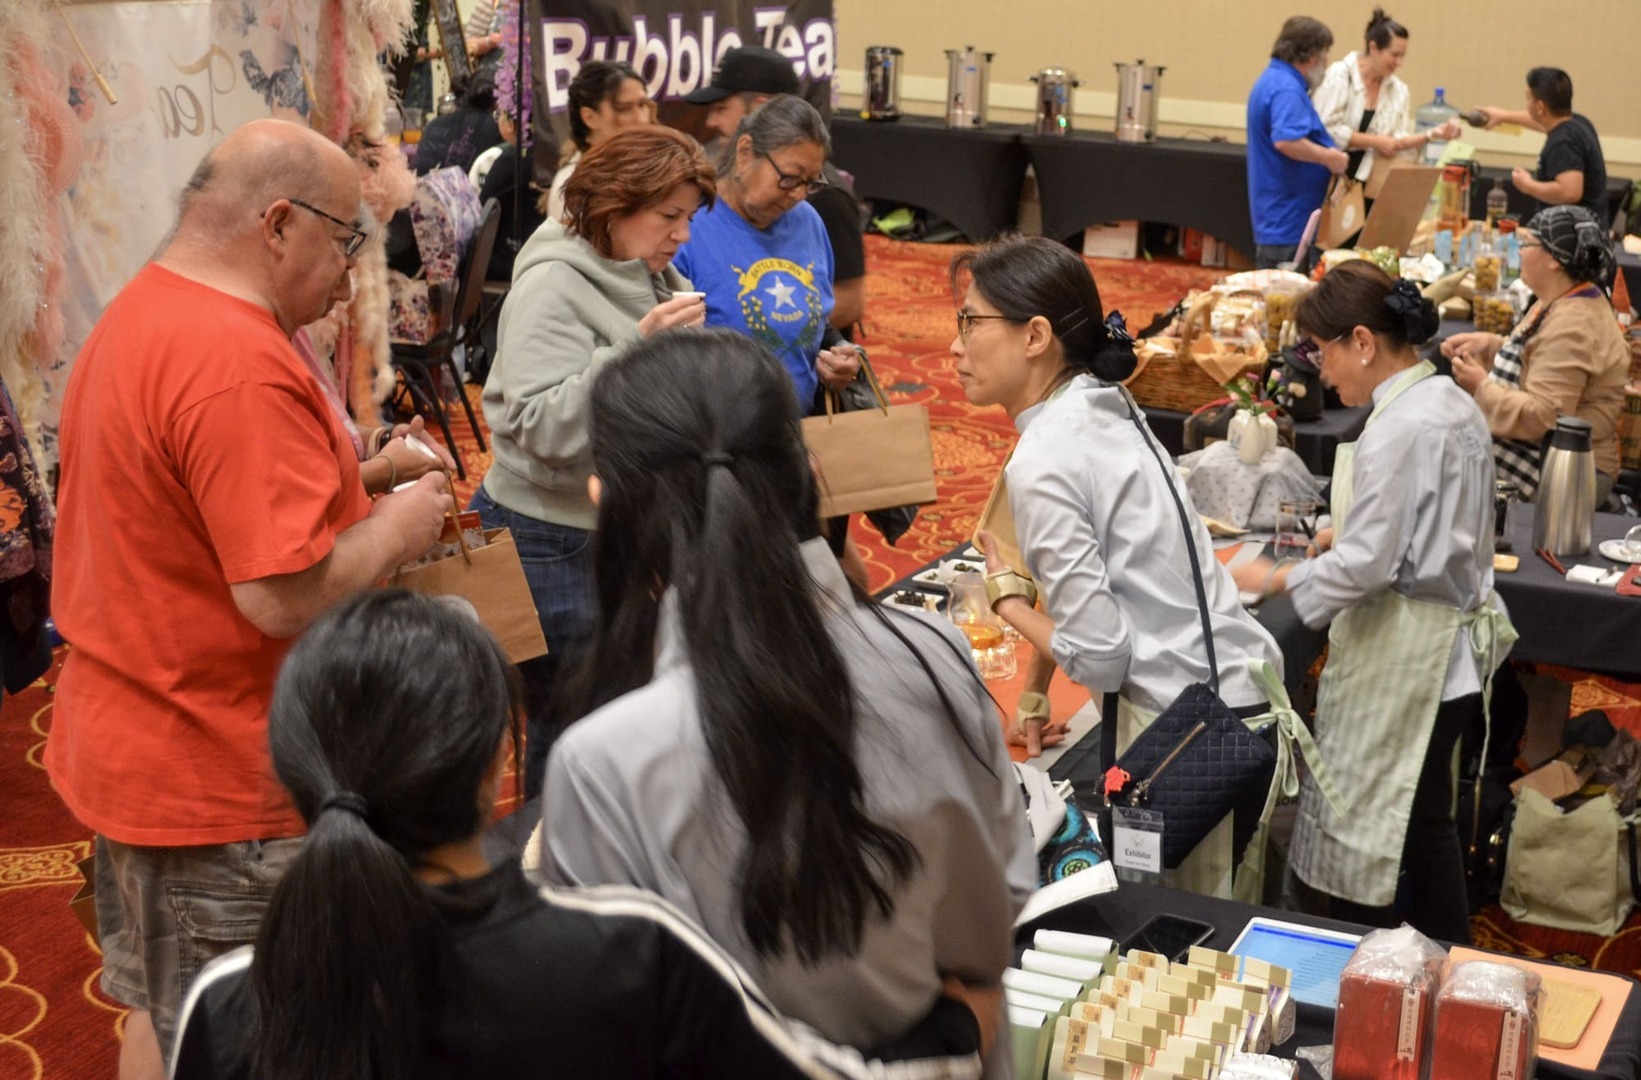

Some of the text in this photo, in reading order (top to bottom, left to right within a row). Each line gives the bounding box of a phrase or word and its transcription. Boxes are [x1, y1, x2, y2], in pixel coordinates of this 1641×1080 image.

[541, 8, 834, 110] Bbbl Tea
[751, 260, 803, 279] BATTLE BORN
[1124, 847, 1152, 860] Exhibitor
